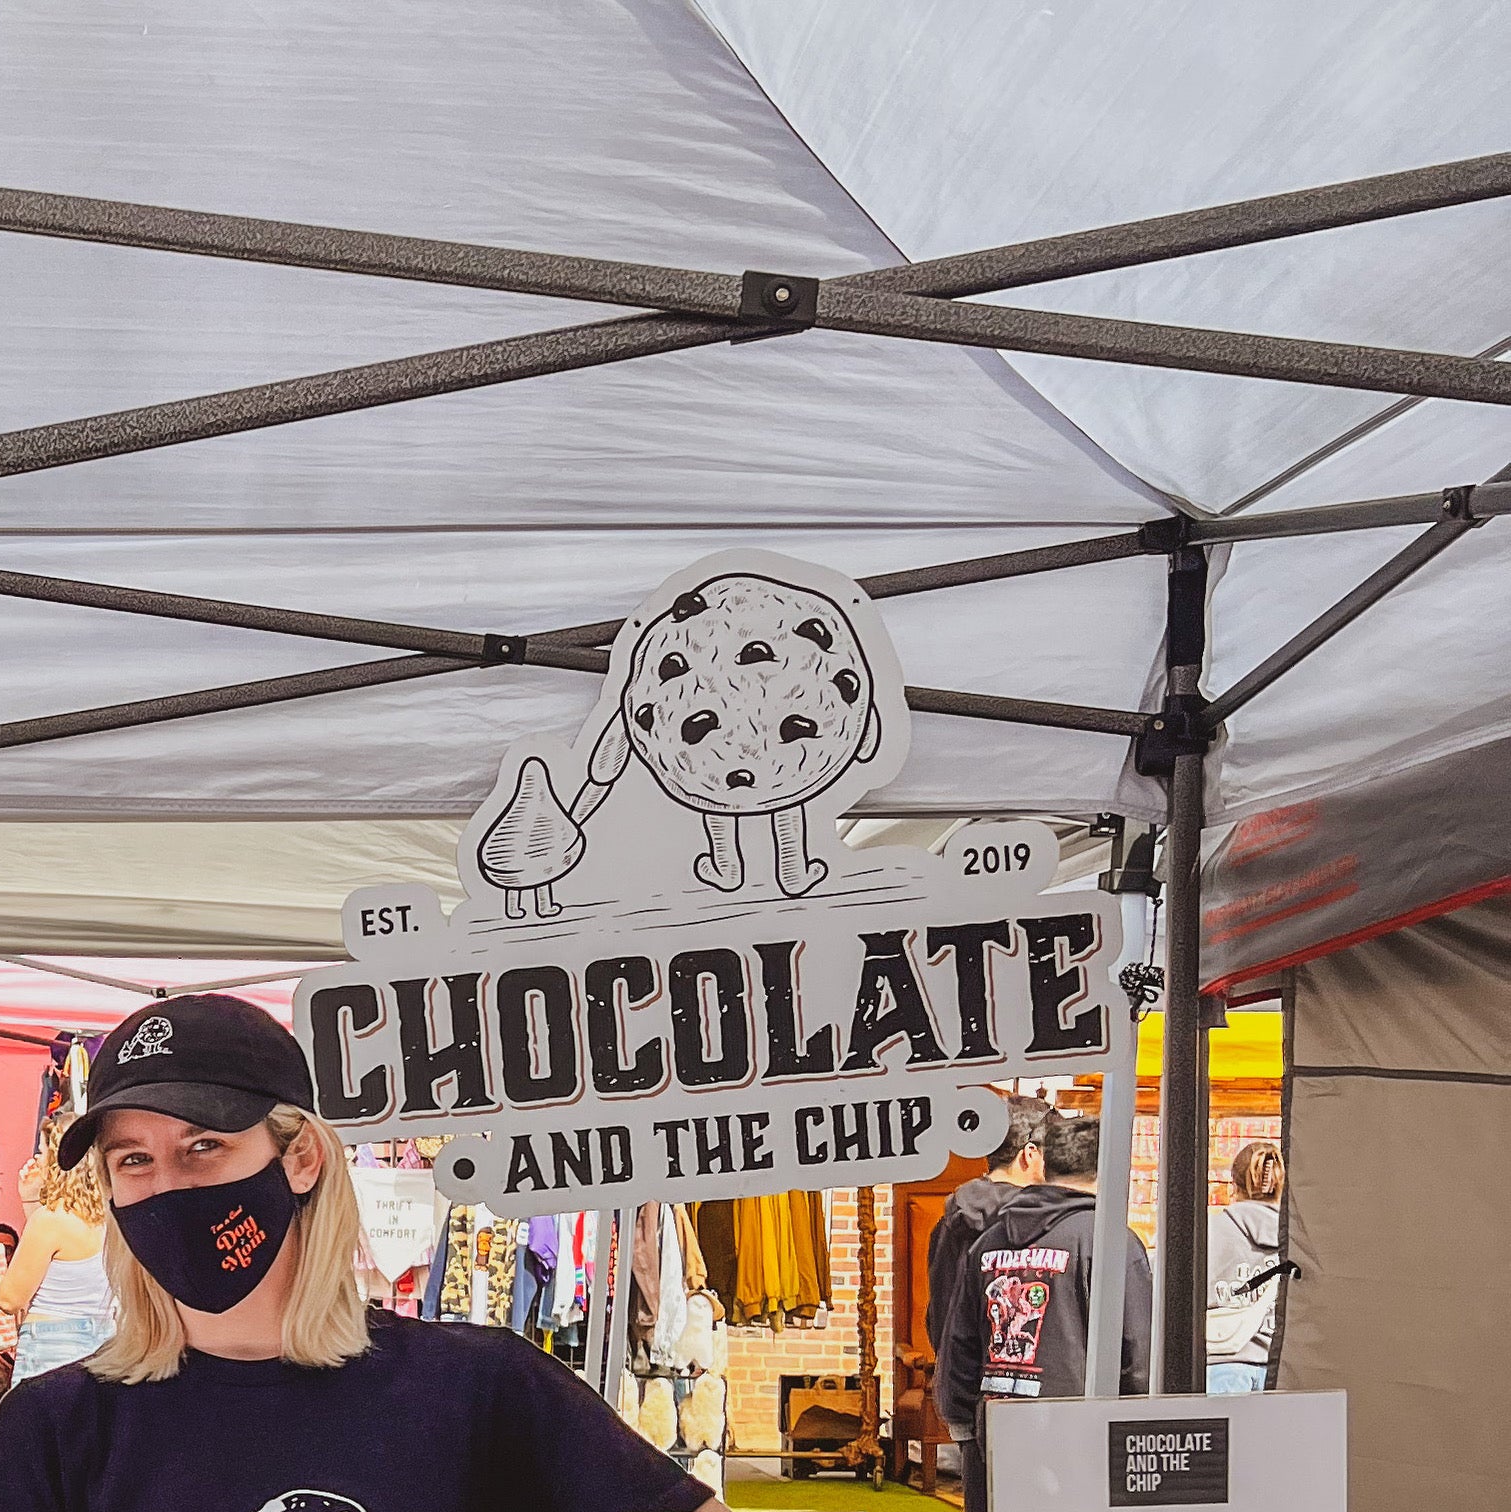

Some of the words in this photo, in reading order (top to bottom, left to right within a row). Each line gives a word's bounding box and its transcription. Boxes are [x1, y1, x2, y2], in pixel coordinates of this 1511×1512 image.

[962, 843, 1031, 876] 2019
[360, 905, 420, 936] EST.
[310, 912, 1107, 1124] CHOCOLATE
[503, 1125, 633, 1195] AND
[653, 1112, 775, 1179] THE
[794, 1096, 932, 1165] CHIP
[376, 1200, 413, 1211] THRIFT
[388, 1214, 399, 1225] IN
[216, 1215, 258, 1251] Dog
[369, 1228, 417, 1239] COMFORT
[1126, 1432, 1212, 1453] CHOCOLATE
[1126, 1454, 1158, 1472] AND
[1160, 1453, 1190, 1472] THE
[1126, 1473, 1162, 1492] CHIP
